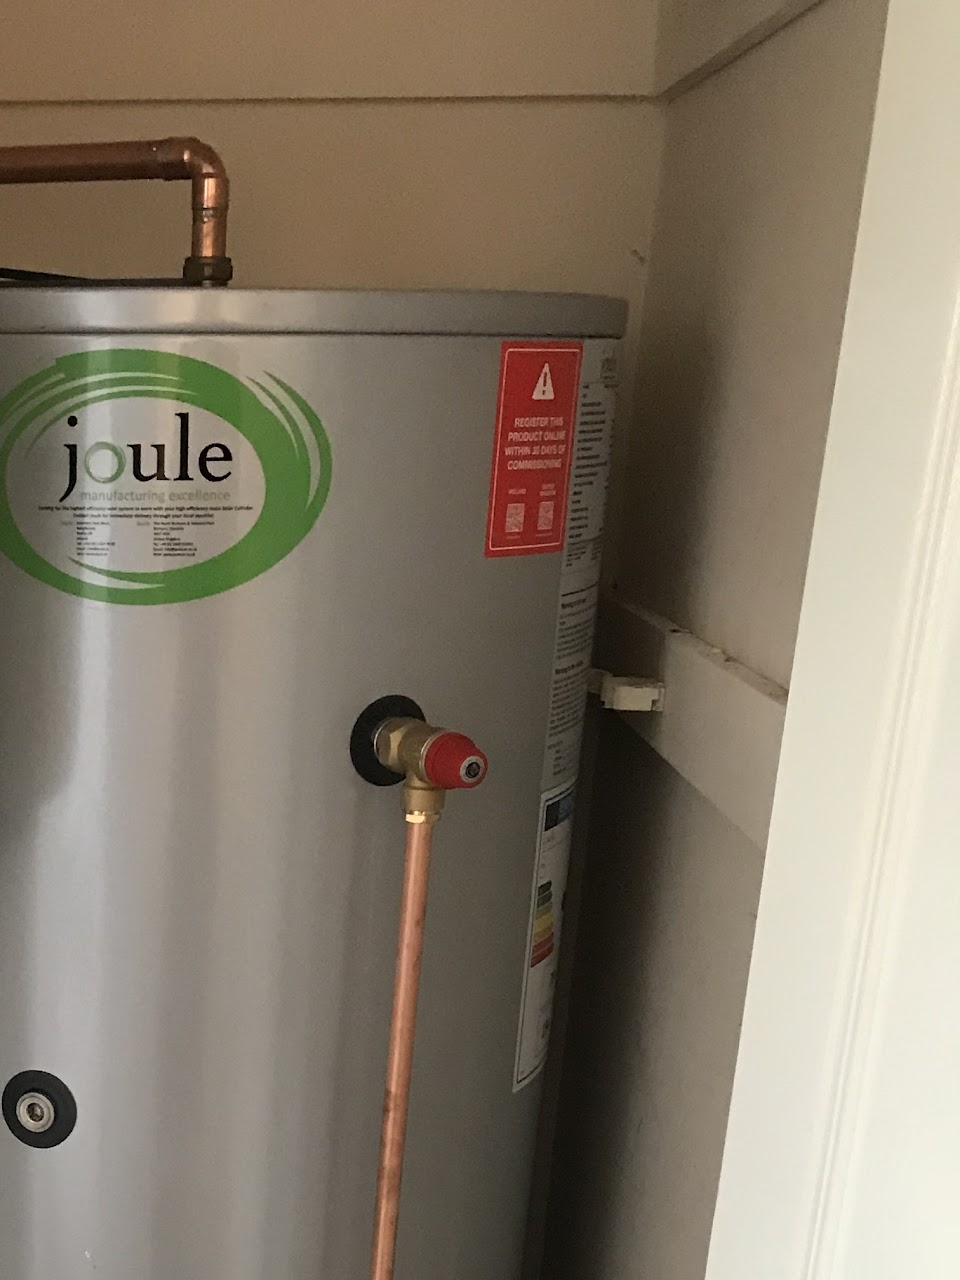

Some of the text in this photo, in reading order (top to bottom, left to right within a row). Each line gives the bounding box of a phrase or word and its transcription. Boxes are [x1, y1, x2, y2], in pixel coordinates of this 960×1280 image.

[513, 416, 564, 428] REGISTER THIS
[507, 430, 566, 442] PRODUCT ONLINE
[59, 412, 233, 502] joule
[505, 446, 530, 456] WITHIN
[507, 459, 562, 471] COMMISSIONING
[80, 489, 231, 503] manufacturing excellence
